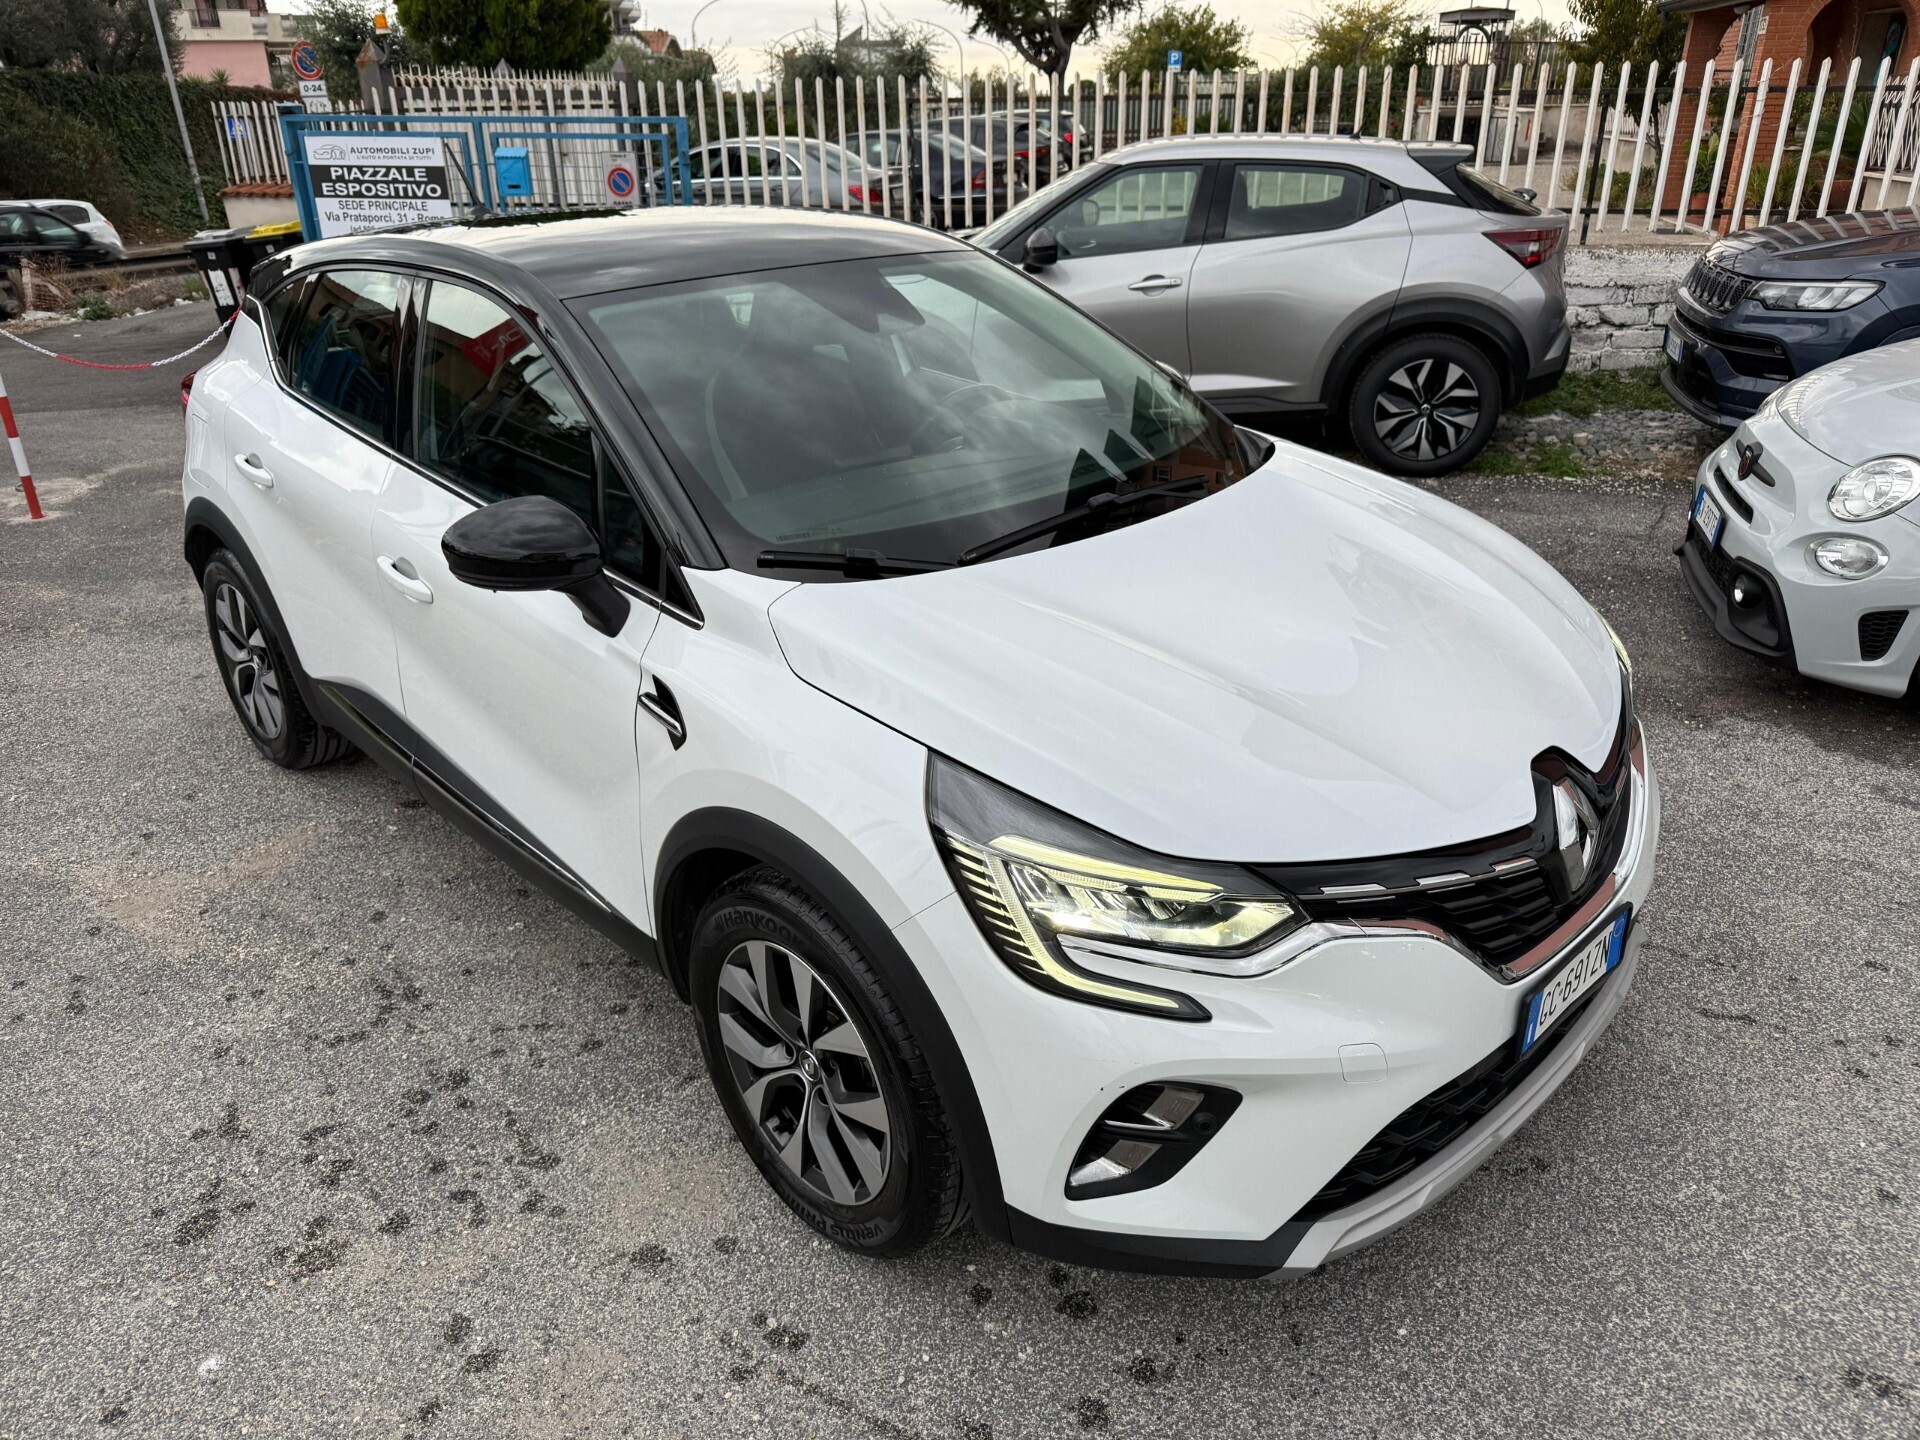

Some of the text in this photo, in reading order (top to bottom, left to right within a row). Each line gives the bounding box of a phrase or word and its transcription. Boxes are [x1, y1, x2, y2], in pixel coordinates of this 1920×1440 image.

[303, 83, 322, 92] 0-24
[350, 147, 435, 155] AUTOMOBILI ZUPI
[330, 167, 428, 181] PIAZZALE
[321, 183, 442, 197] ESPOSITIVO
[338, 200, 428, 211] SEDE PRINCIPALE
[325, 212, 340, 222] Via
[343, 212, 396, 224] Prataporci,
[397, 213, 409, 223] 31
